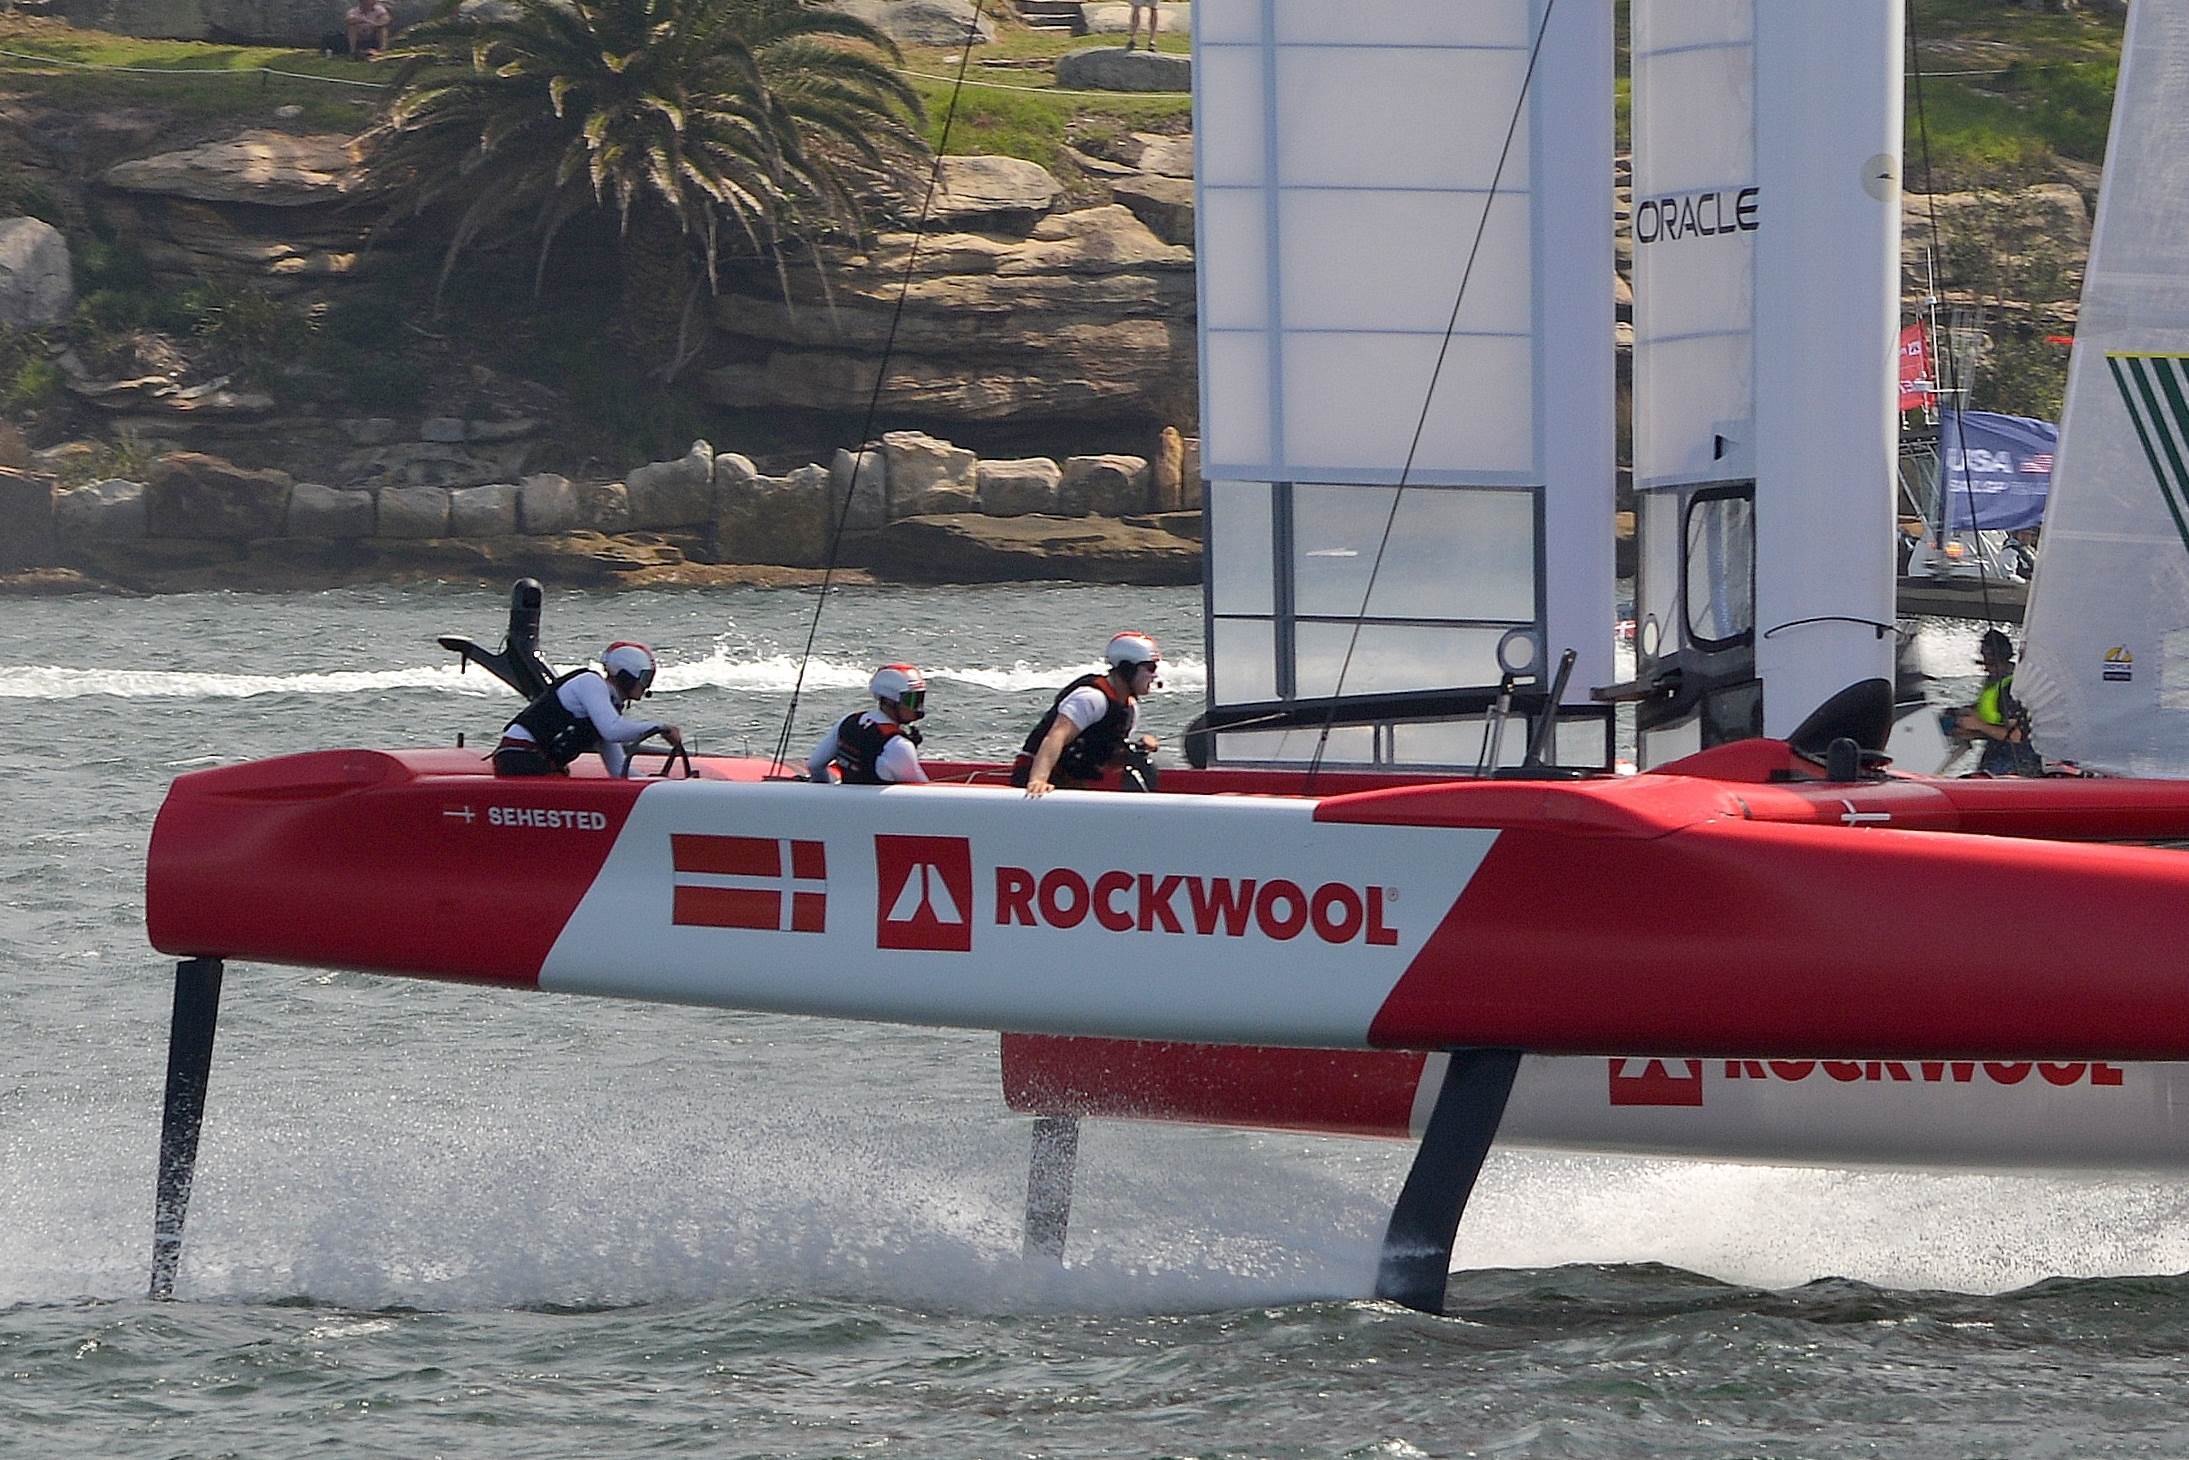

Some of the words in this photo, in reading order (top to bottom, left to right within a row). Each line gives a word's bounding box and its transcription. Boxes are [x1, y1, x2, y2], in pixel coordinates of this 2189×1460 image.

[1637, 187, 1759, 243] ORACLE
[1946, 448, 2014, 473] USA
[488, 806, 606, 830] SEHESTED
